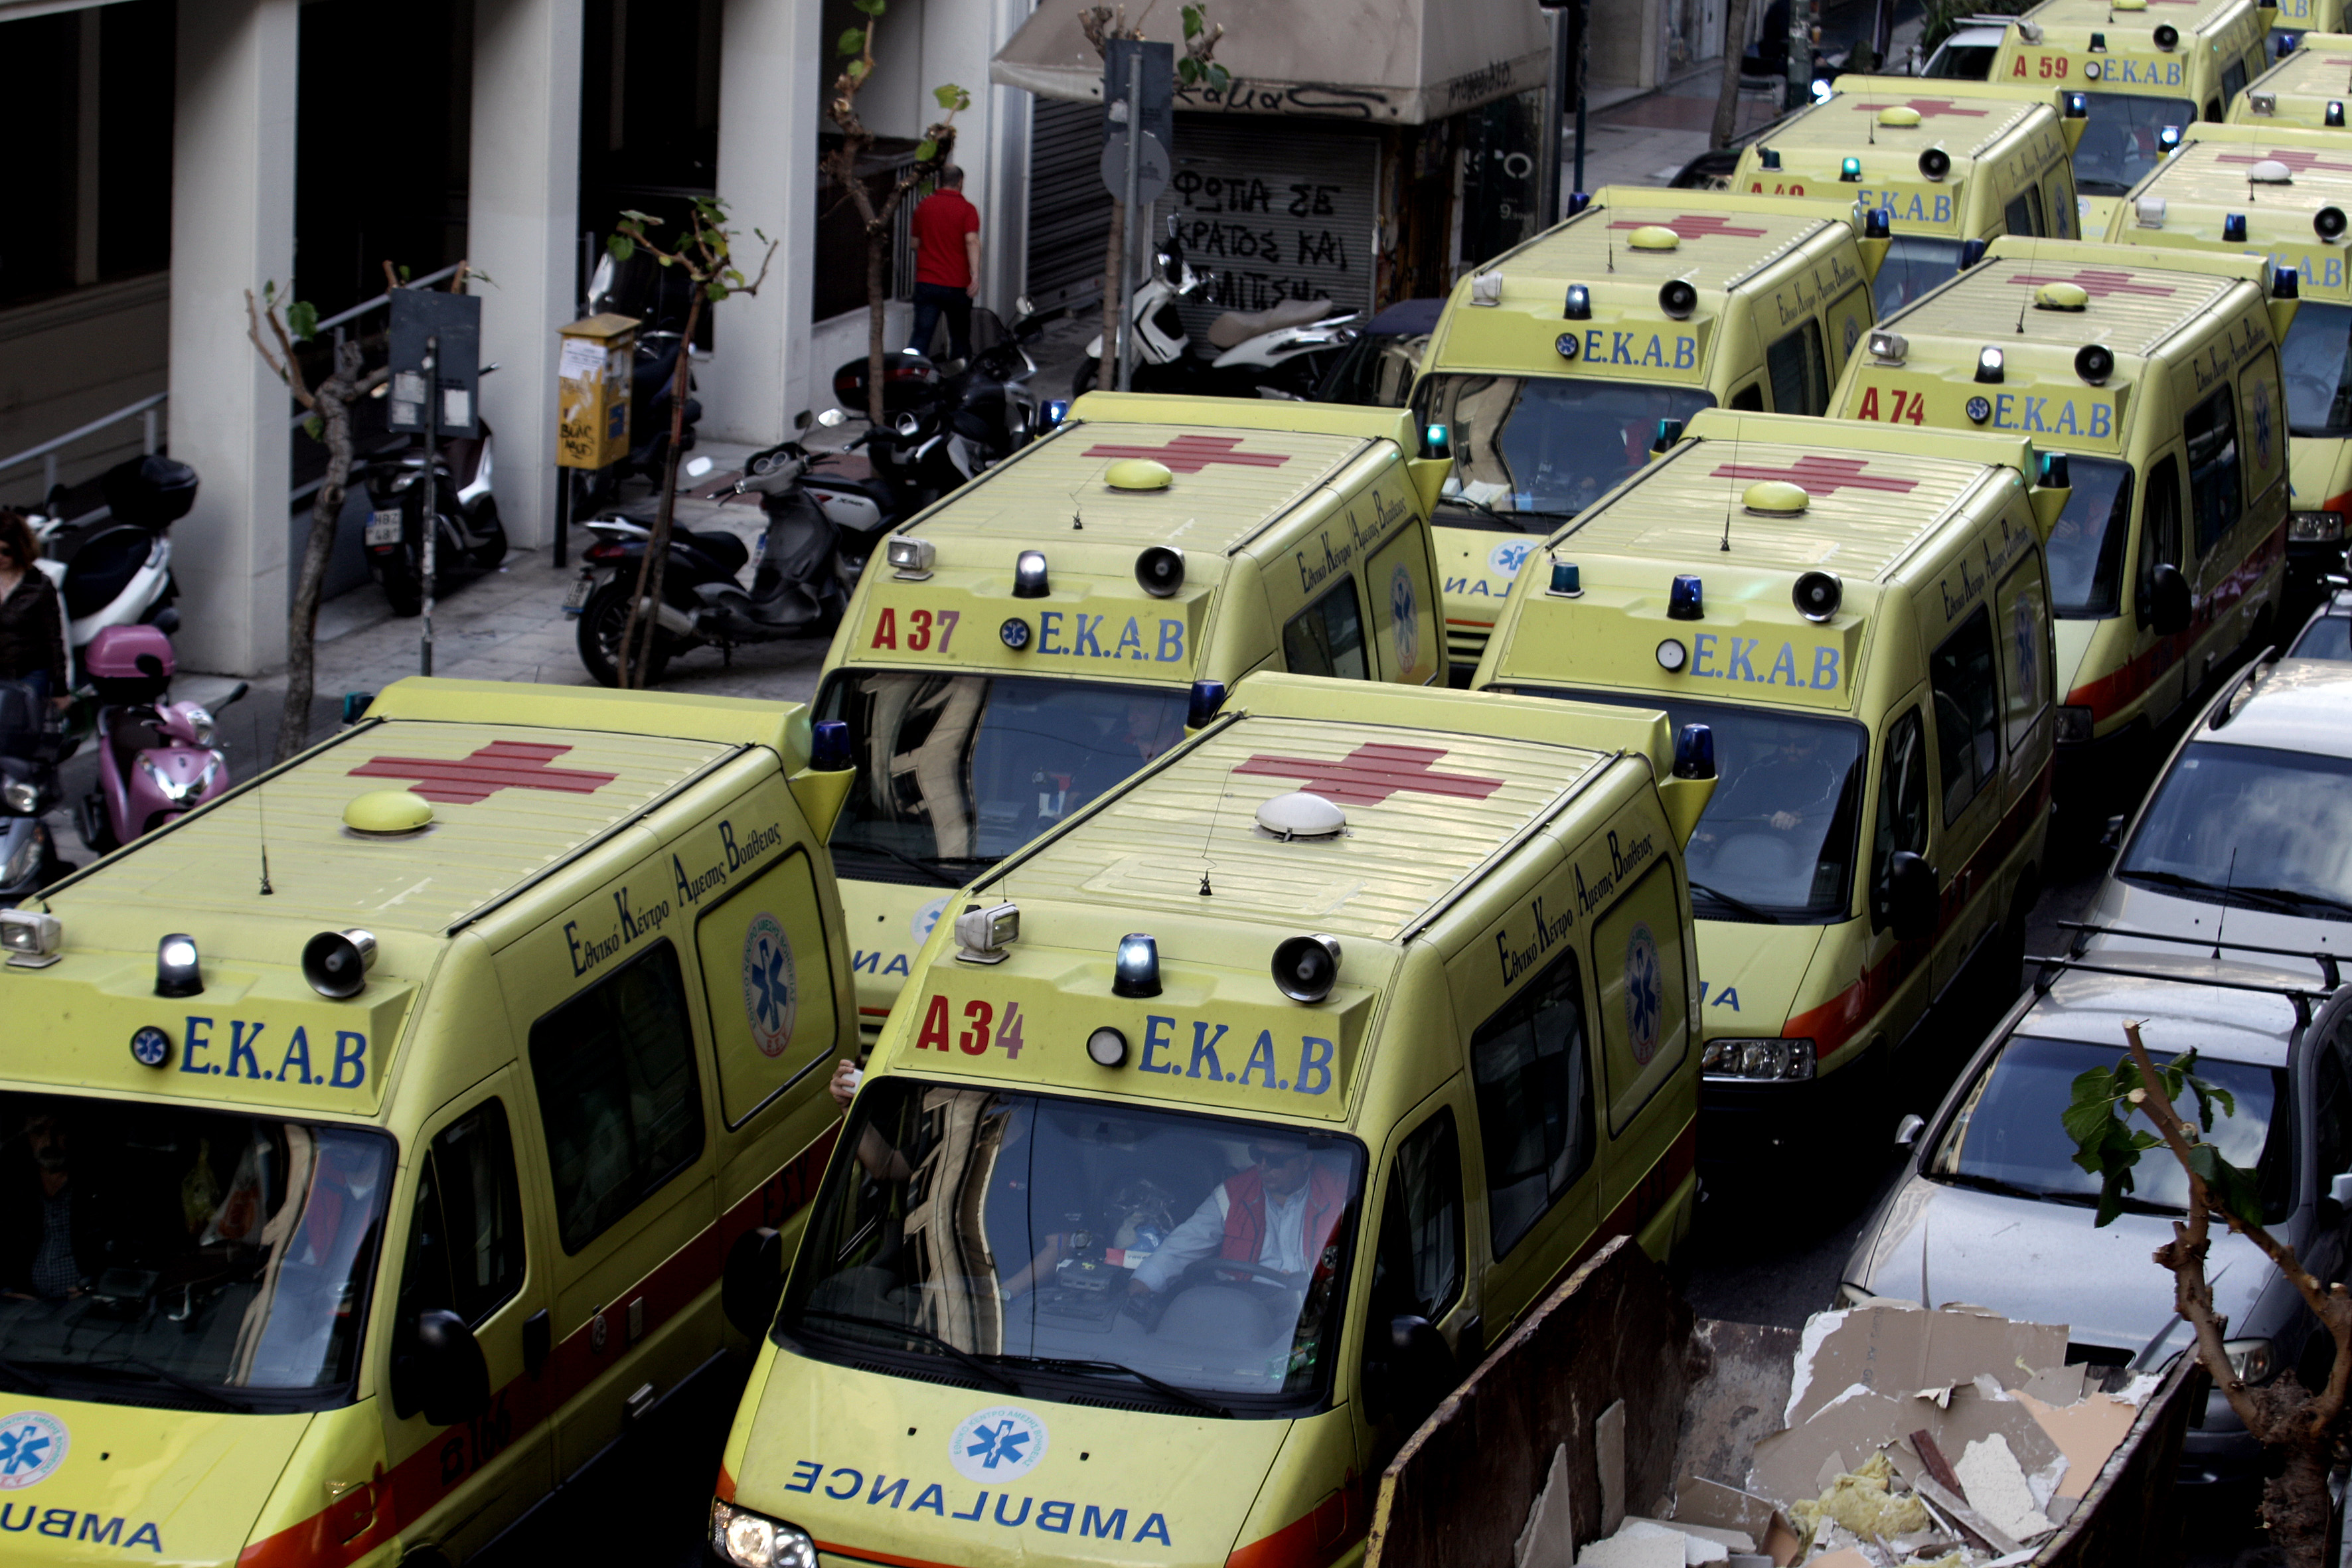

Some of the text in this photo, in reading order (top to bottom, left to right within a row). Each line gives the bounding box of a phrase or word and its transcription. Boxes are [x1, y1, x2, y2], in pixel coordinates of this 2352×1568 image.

[2039, 56, 2069, 79] 59
[563, 920, 619, 979] Εθνικό
[613, 887, 669, 944] Κέντρο
[1496, 929, 1537, 987] Εθνικό
[1531, 896, 1573, 953] Κέντρο
